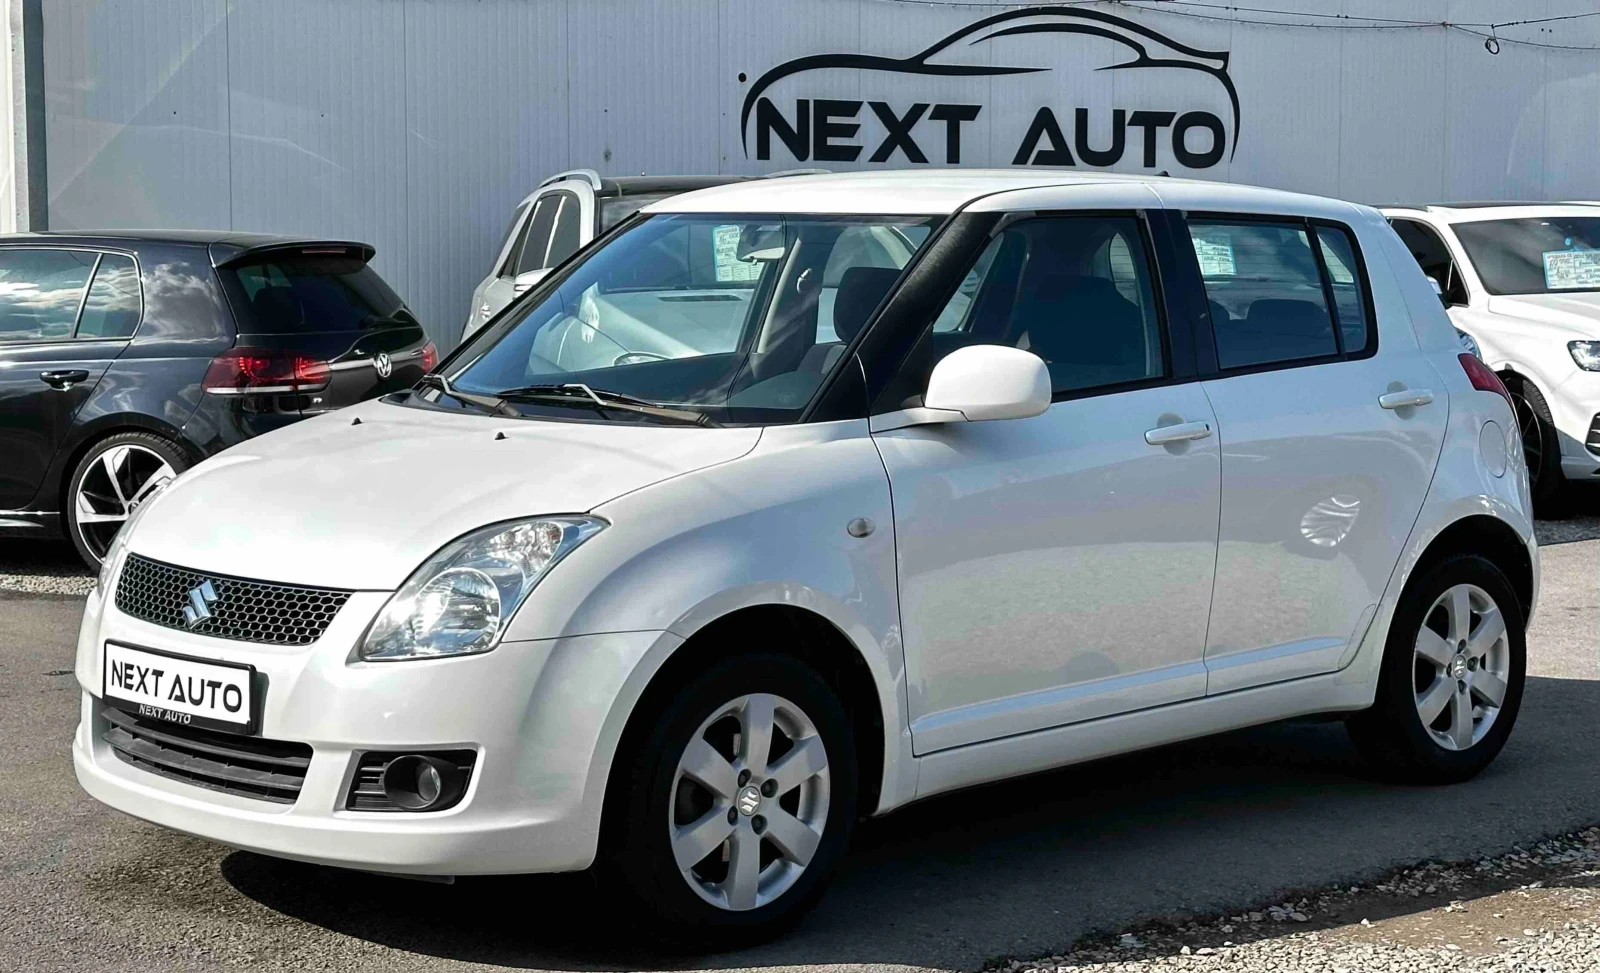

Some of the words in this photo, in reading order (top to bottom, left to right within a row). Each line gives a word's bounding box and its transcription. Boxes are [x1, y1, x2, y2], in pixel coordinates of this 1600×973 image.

[756, 97, 982, 164] NEXT
[1011, 106, 1226, 168] AUTO
[111, 658, 164, 697] NEXT
[167, 673, 242, 713] AUTO
[138, 704, 164, 719] NEXT
[165, 710, 192, 724] AUTO
